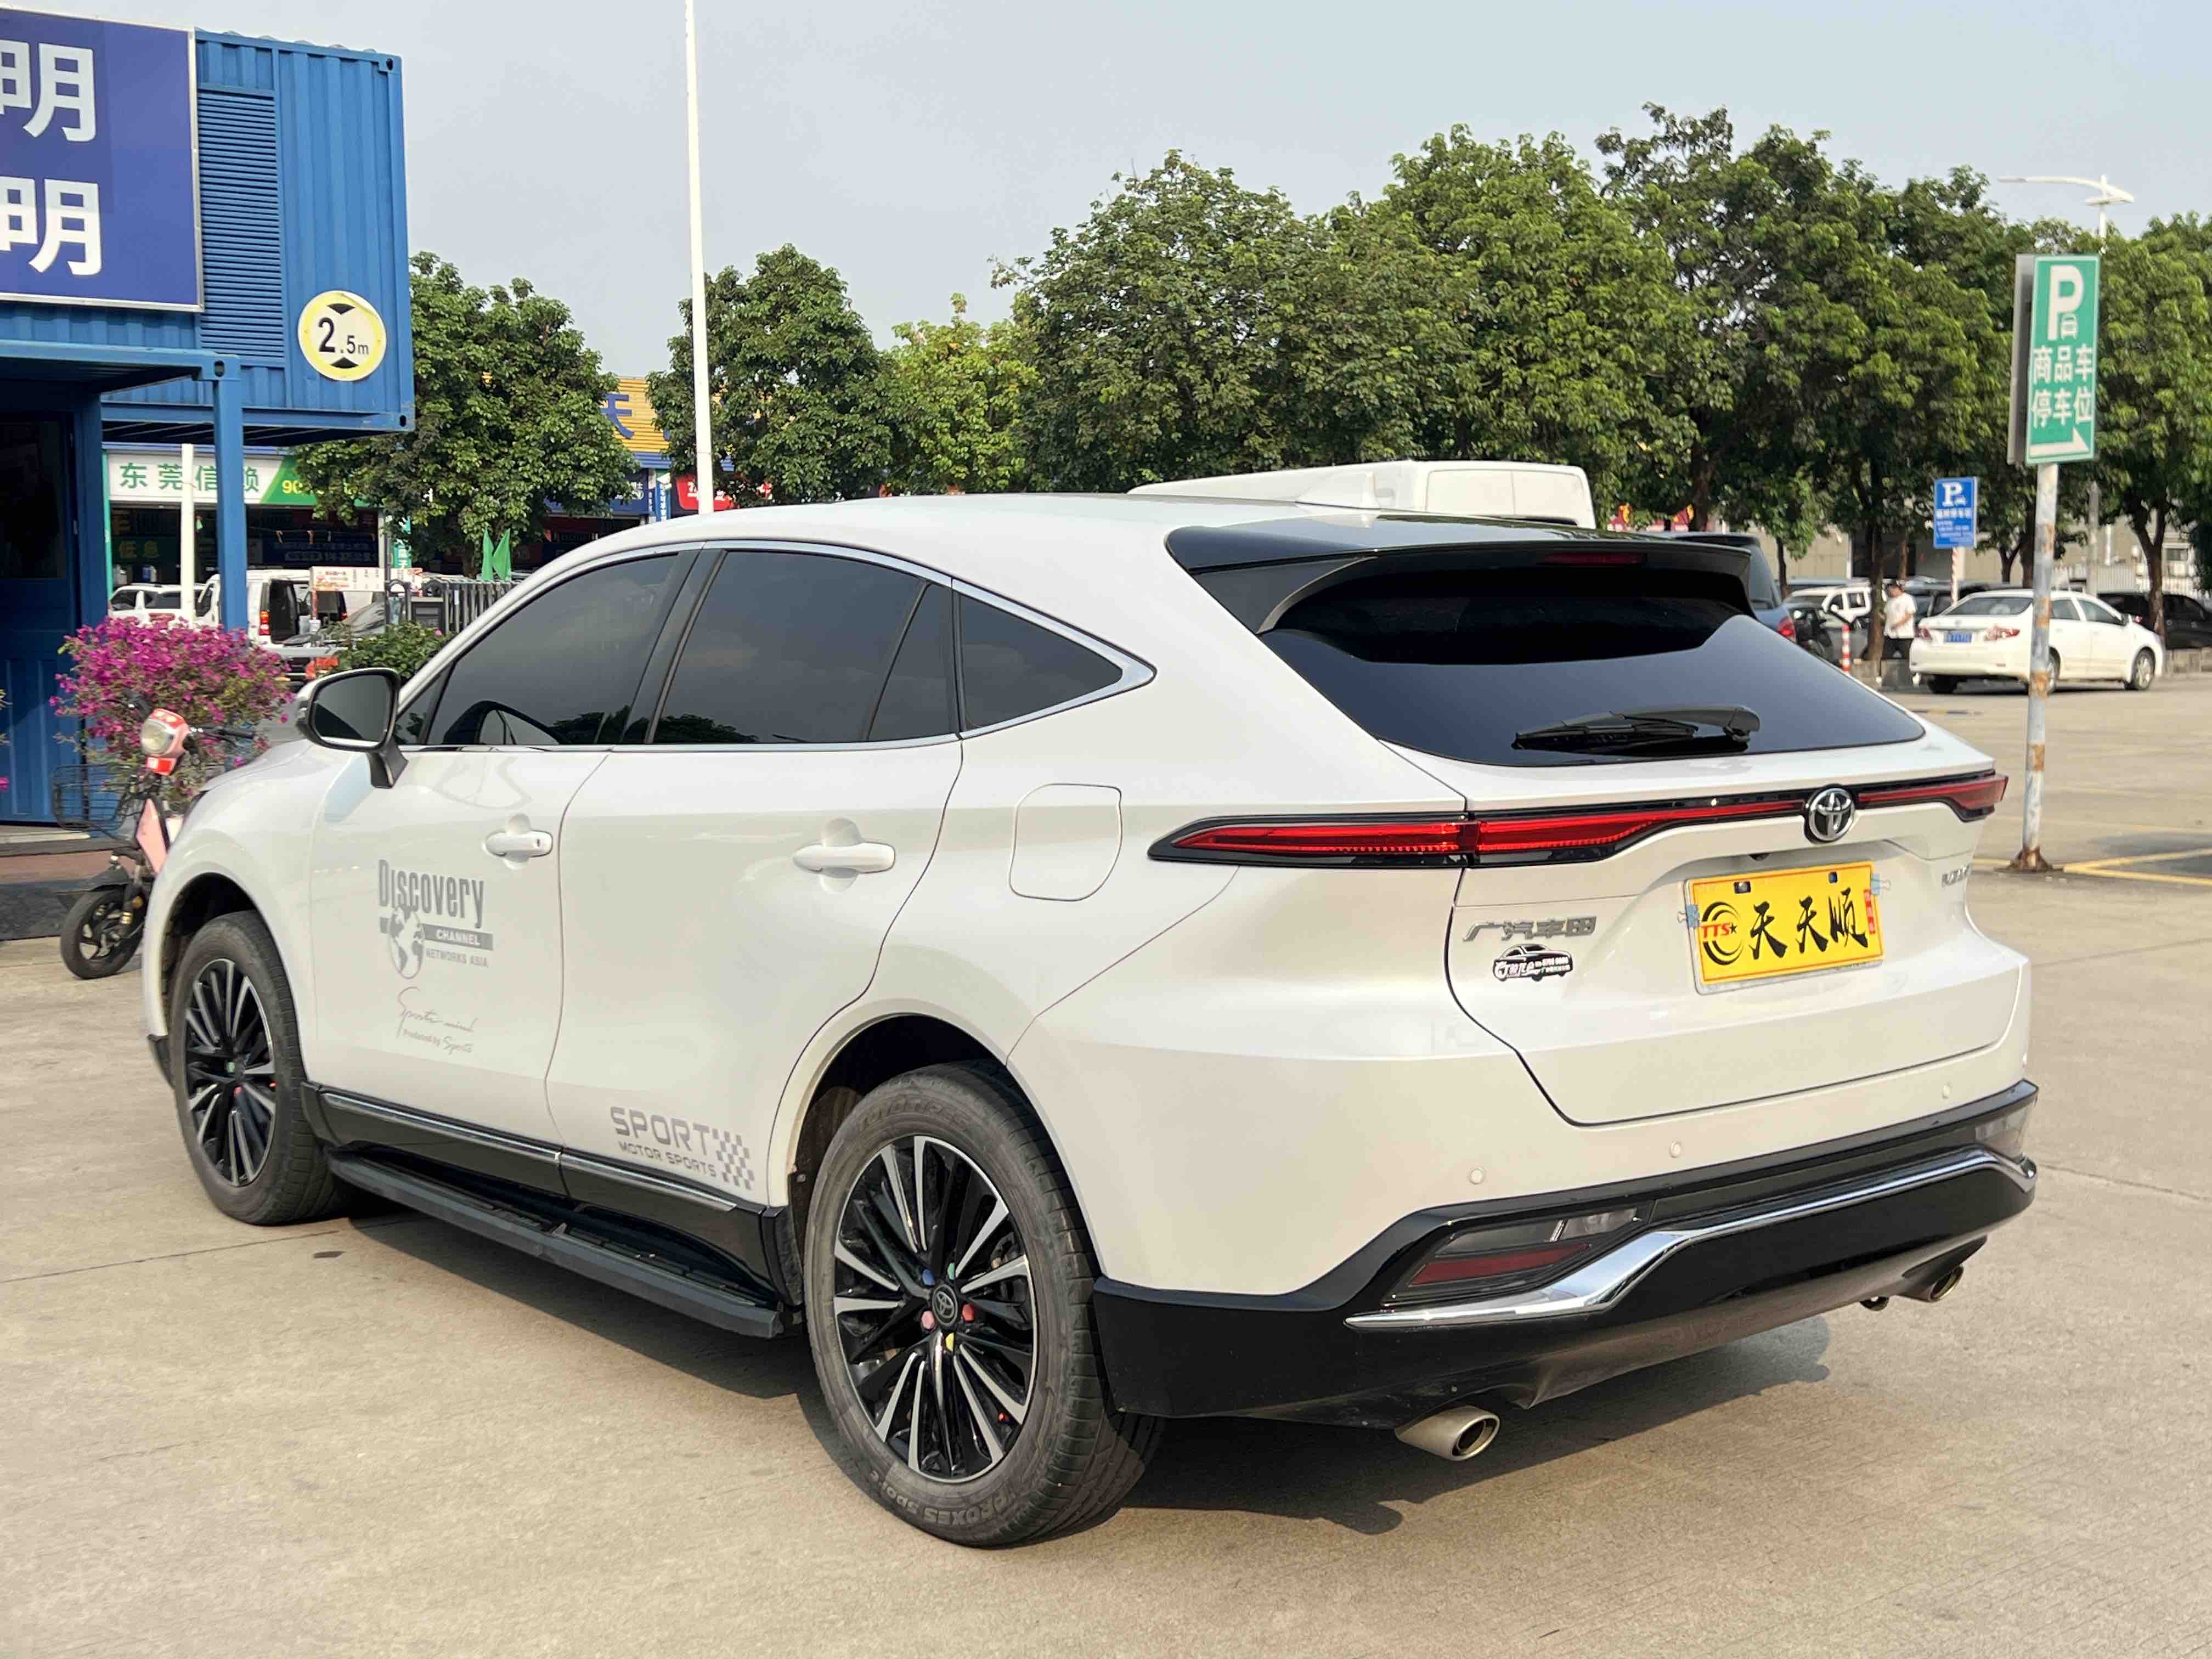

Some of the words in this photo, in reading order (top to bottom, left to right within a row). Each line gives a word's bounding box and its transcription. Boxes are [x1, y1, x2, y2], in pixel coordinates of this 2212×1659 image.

[2047, 265, 2084, 341] P
[2032, 344, 2093, 384] 商品车
[2031, 386, 2091, 429] 停车位
[1942, 482, 1962, 507] P
[436, 929, 481, 946] CHANNEL
[1702, 922, 1731, 939] TTS
[426, 948, 466, 964] NETWORKS
[611, 1106, 710, 1156] SPORT
[618, 1141, 663, 1161] MOTOR
[665, 1152, 716, 1178] SPORTS
